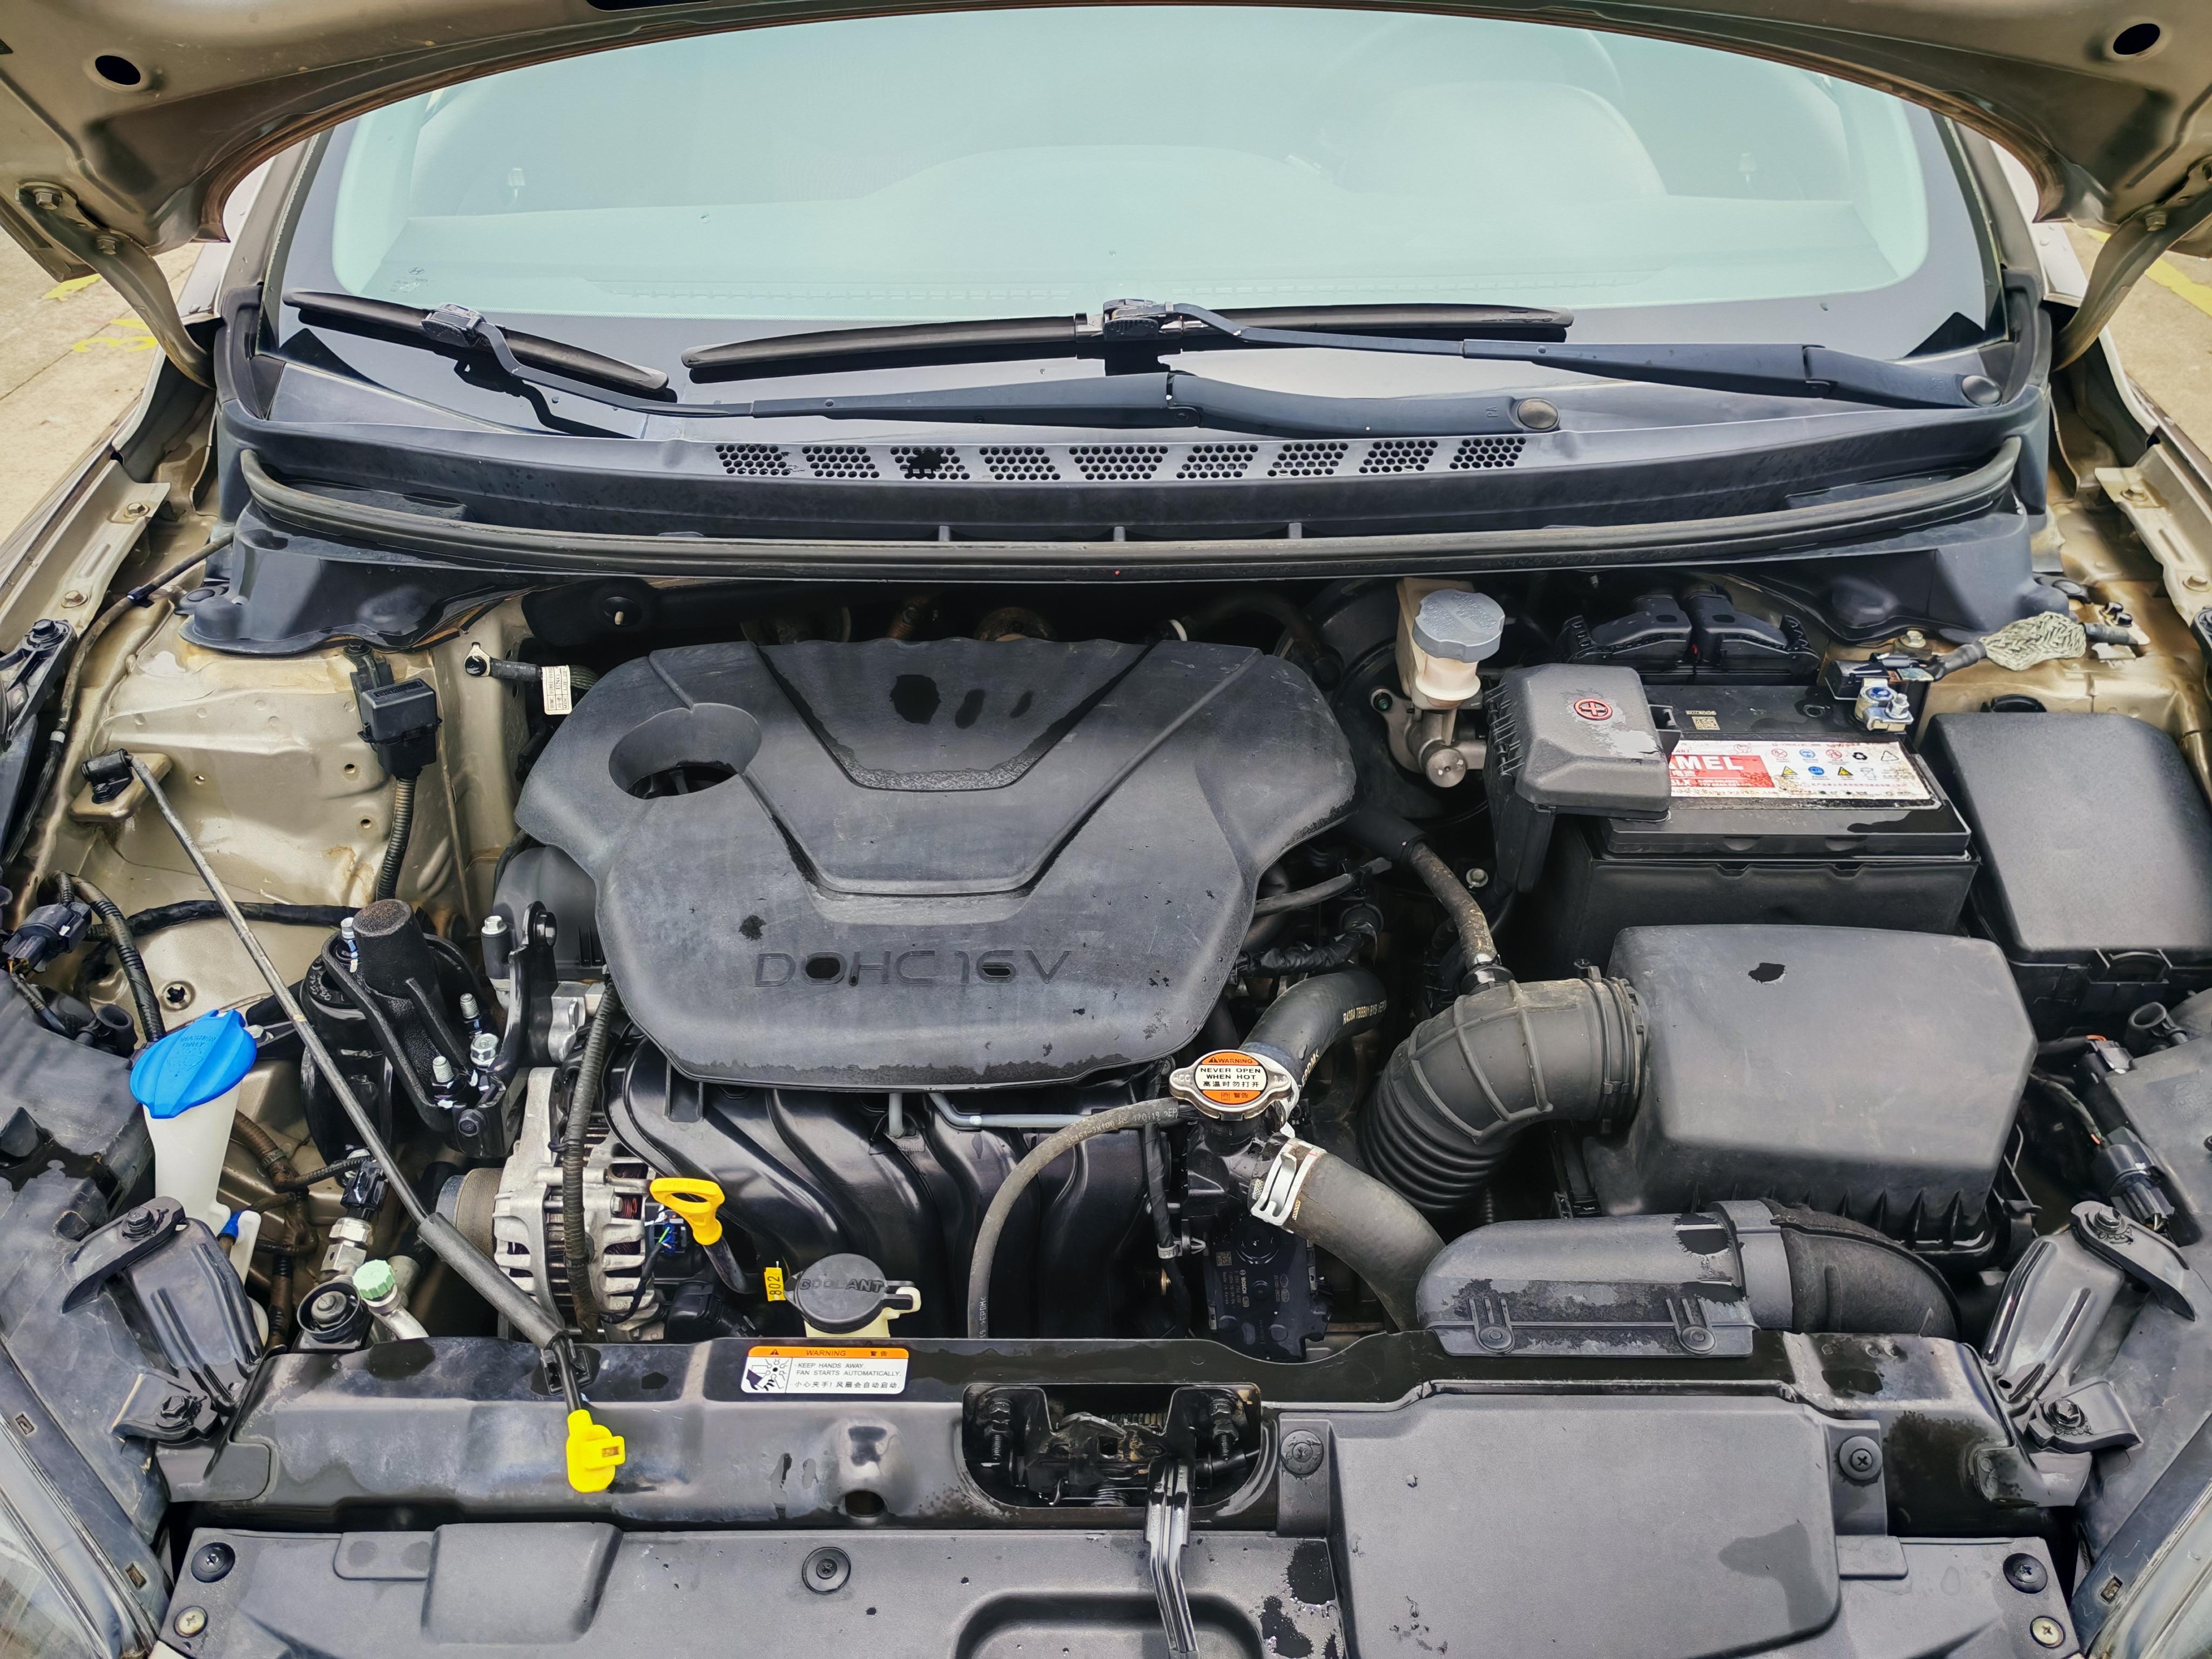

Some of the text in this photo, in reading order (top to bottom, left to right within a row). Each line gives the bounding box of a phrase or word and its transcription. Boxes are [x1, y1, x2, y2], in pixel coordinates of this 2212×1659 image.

[754, 949, 935, 987] DOHC
[767, 1276, 782, 1296] 802
[799, 1278, 885, 1293] COOLANT
